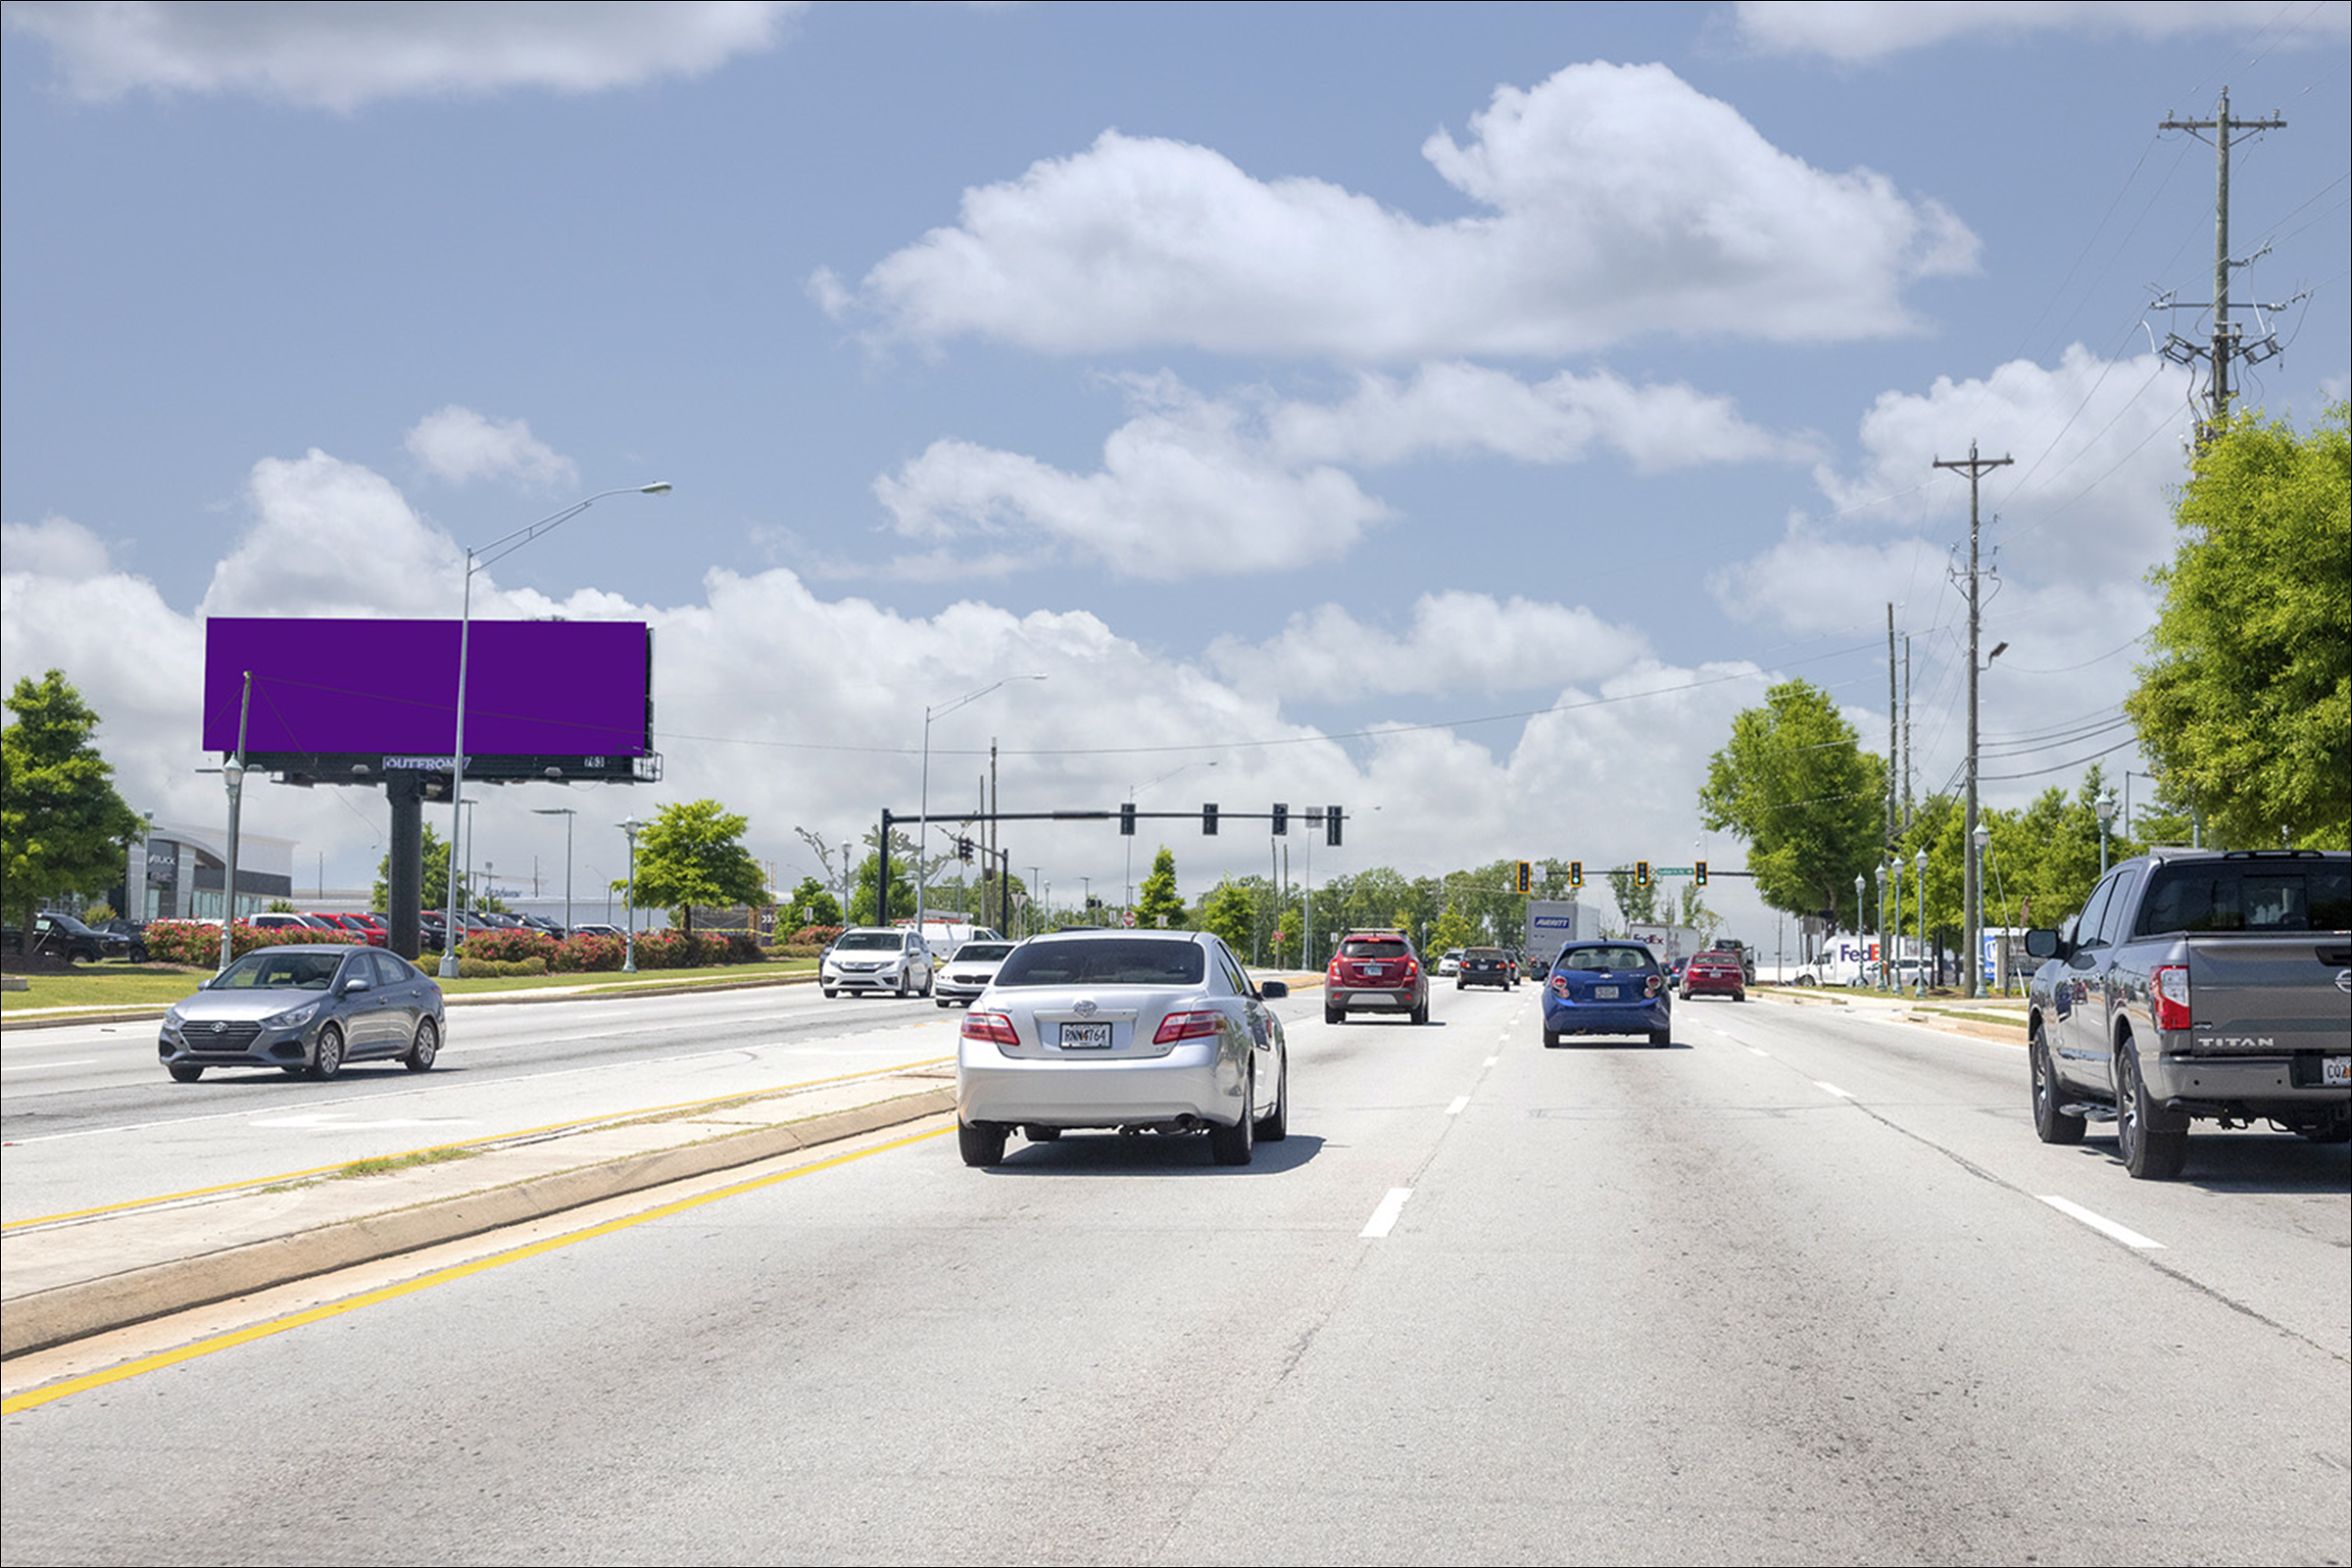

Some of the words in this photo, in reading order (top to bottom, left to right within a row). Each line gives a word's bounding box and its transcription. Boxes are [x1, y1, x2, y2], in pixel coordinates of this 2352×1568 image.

[386, 758, 464, 770] OUTFRON
[1840, 944, 1889, 961] FedE
[2198, 1038, 2274, 1047] TITAN
